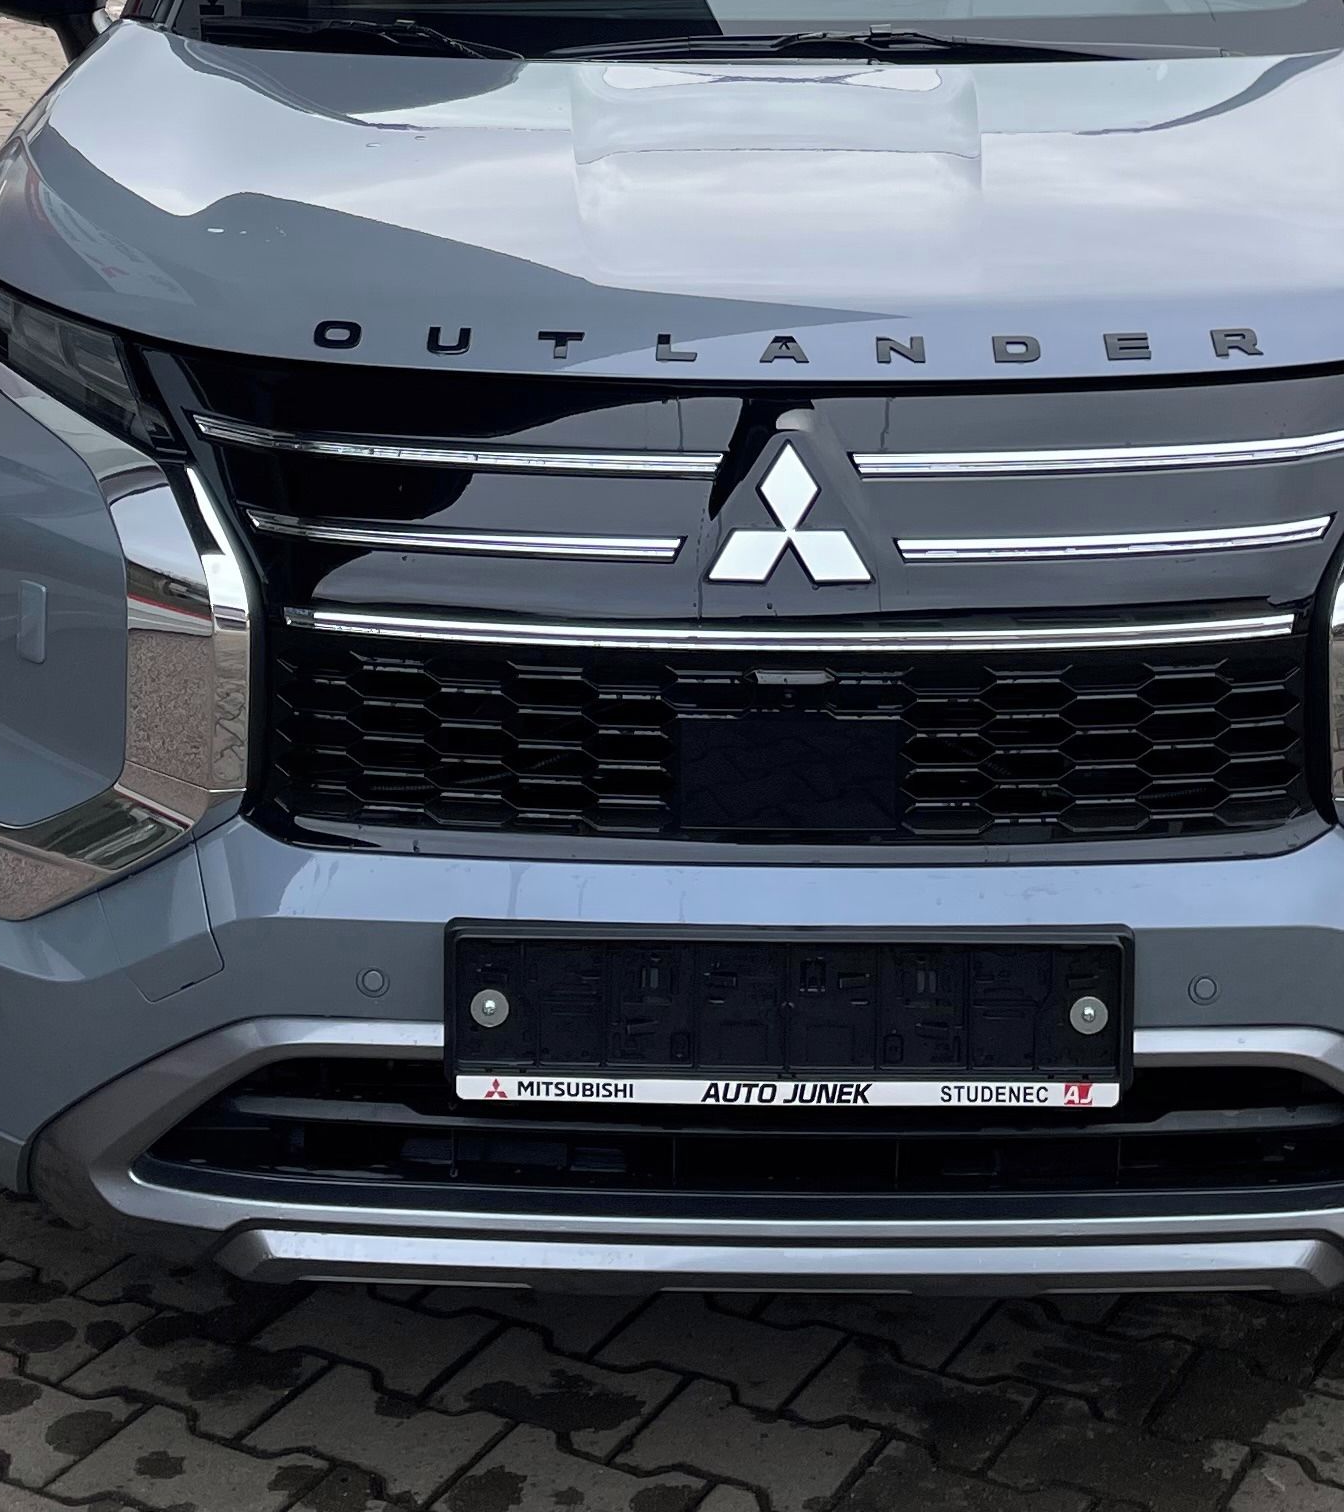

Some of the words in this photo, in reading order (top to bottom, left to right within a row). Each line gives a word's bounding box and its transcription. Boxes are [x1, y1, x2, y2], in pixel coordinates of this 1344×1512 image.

[313, 319, 1263, 364] OUTLANDER
[517, 1080, 634, 1099] MITSUBISHI
[701, 1082, 777, 1104] AUTO
[783, 1083, 873, 1104] JUNEK
[940, 1085, 1049, 1103] STUDENEC
